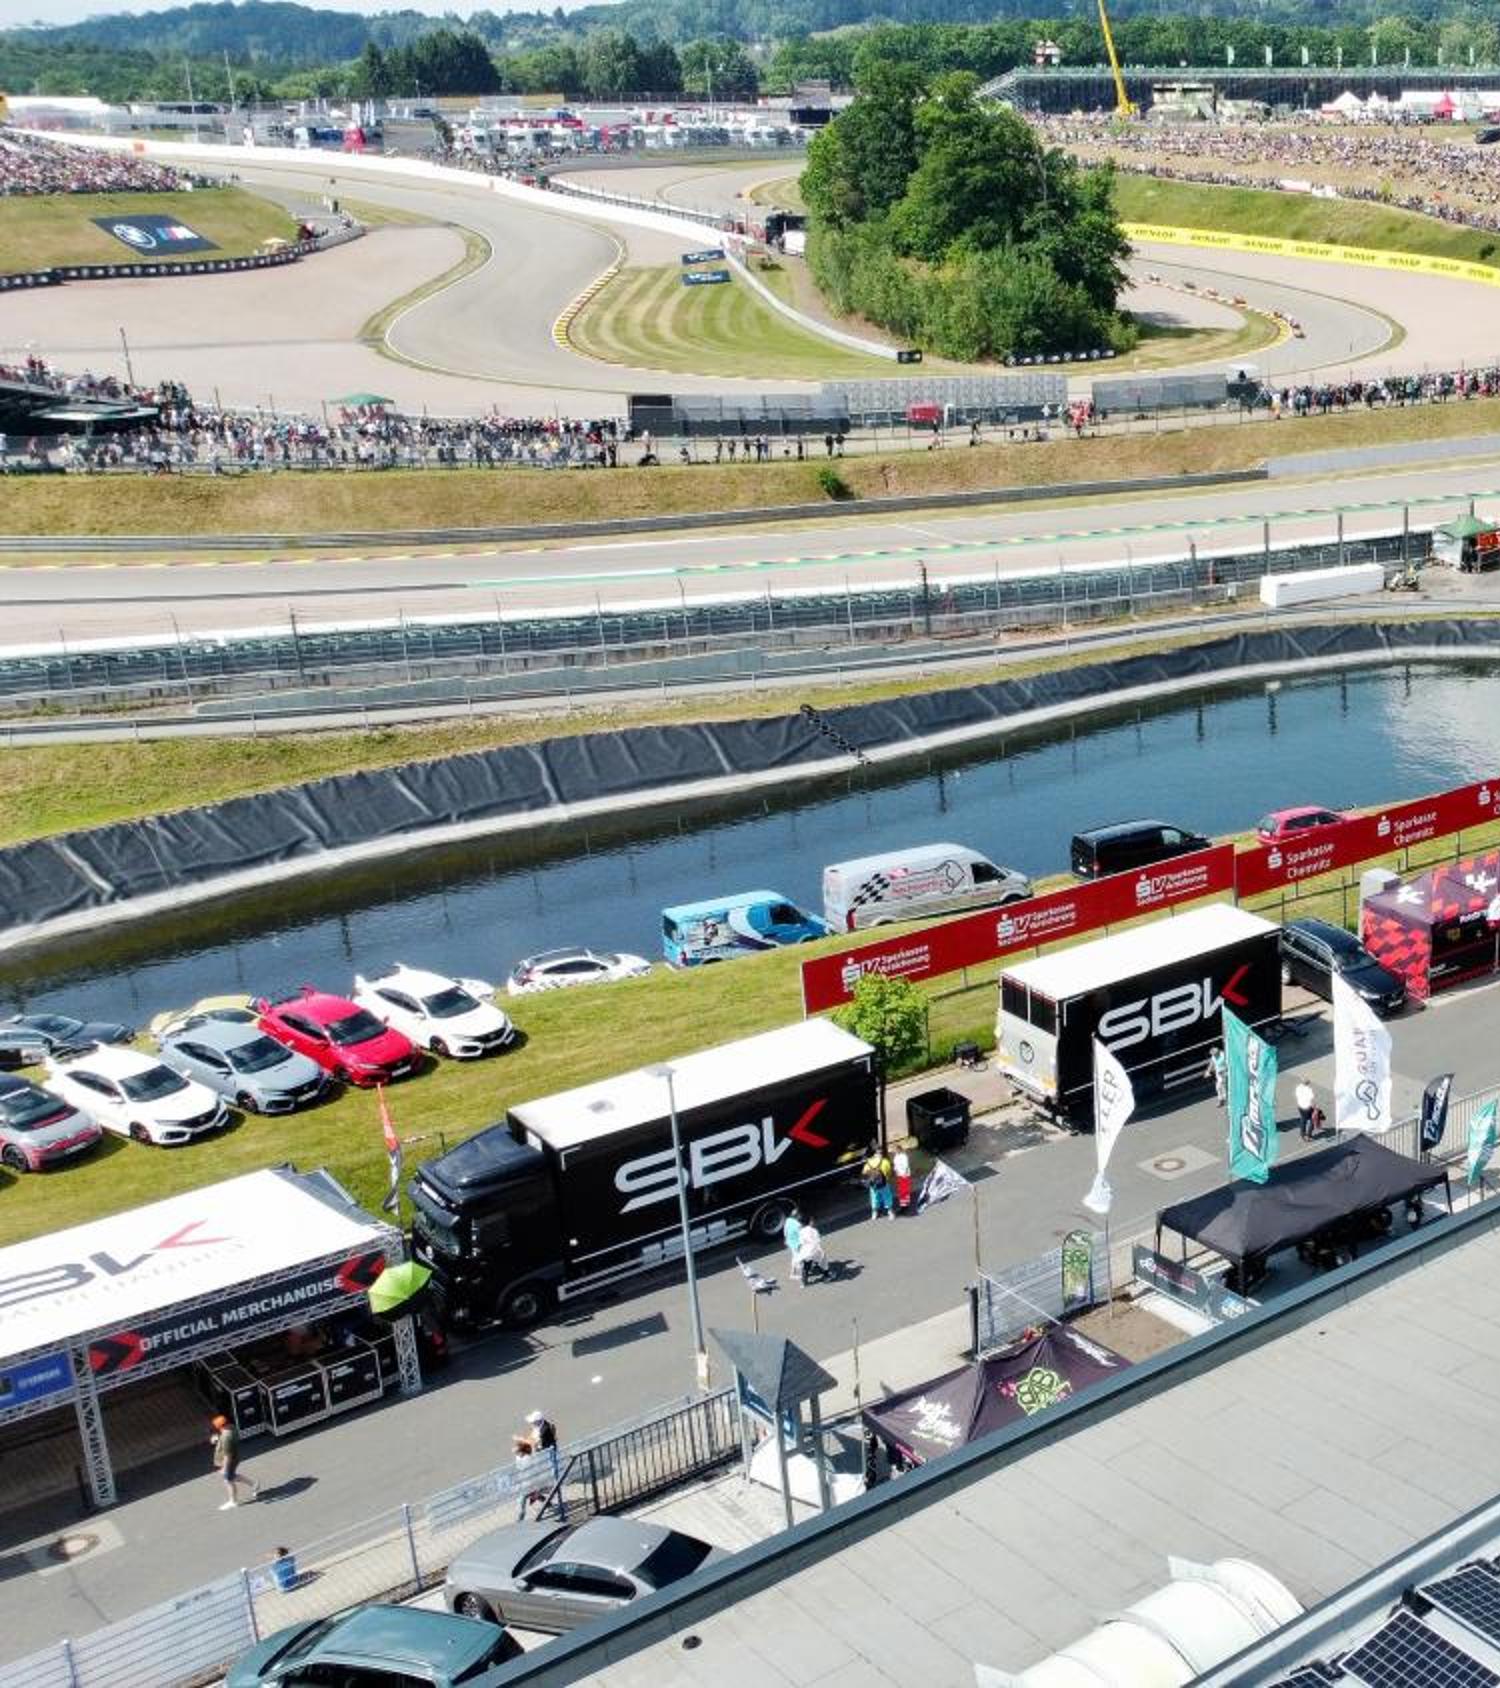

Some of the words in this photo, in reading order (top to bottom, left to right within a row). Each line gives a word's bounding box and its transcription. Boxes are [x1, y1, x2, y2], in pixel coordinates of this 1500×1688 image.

[1286, 843, 1335, 865] Sparkasse
[1393, 811, 1437, 833] Sparkasse
[1098, 963, 1250, 1053] SBK
[614, 1098, 831, 1215] SBK
[140, 1317, 218, 1352] OFFICIAL
[221, 1274, 344, 1326] MERCHANDISE
